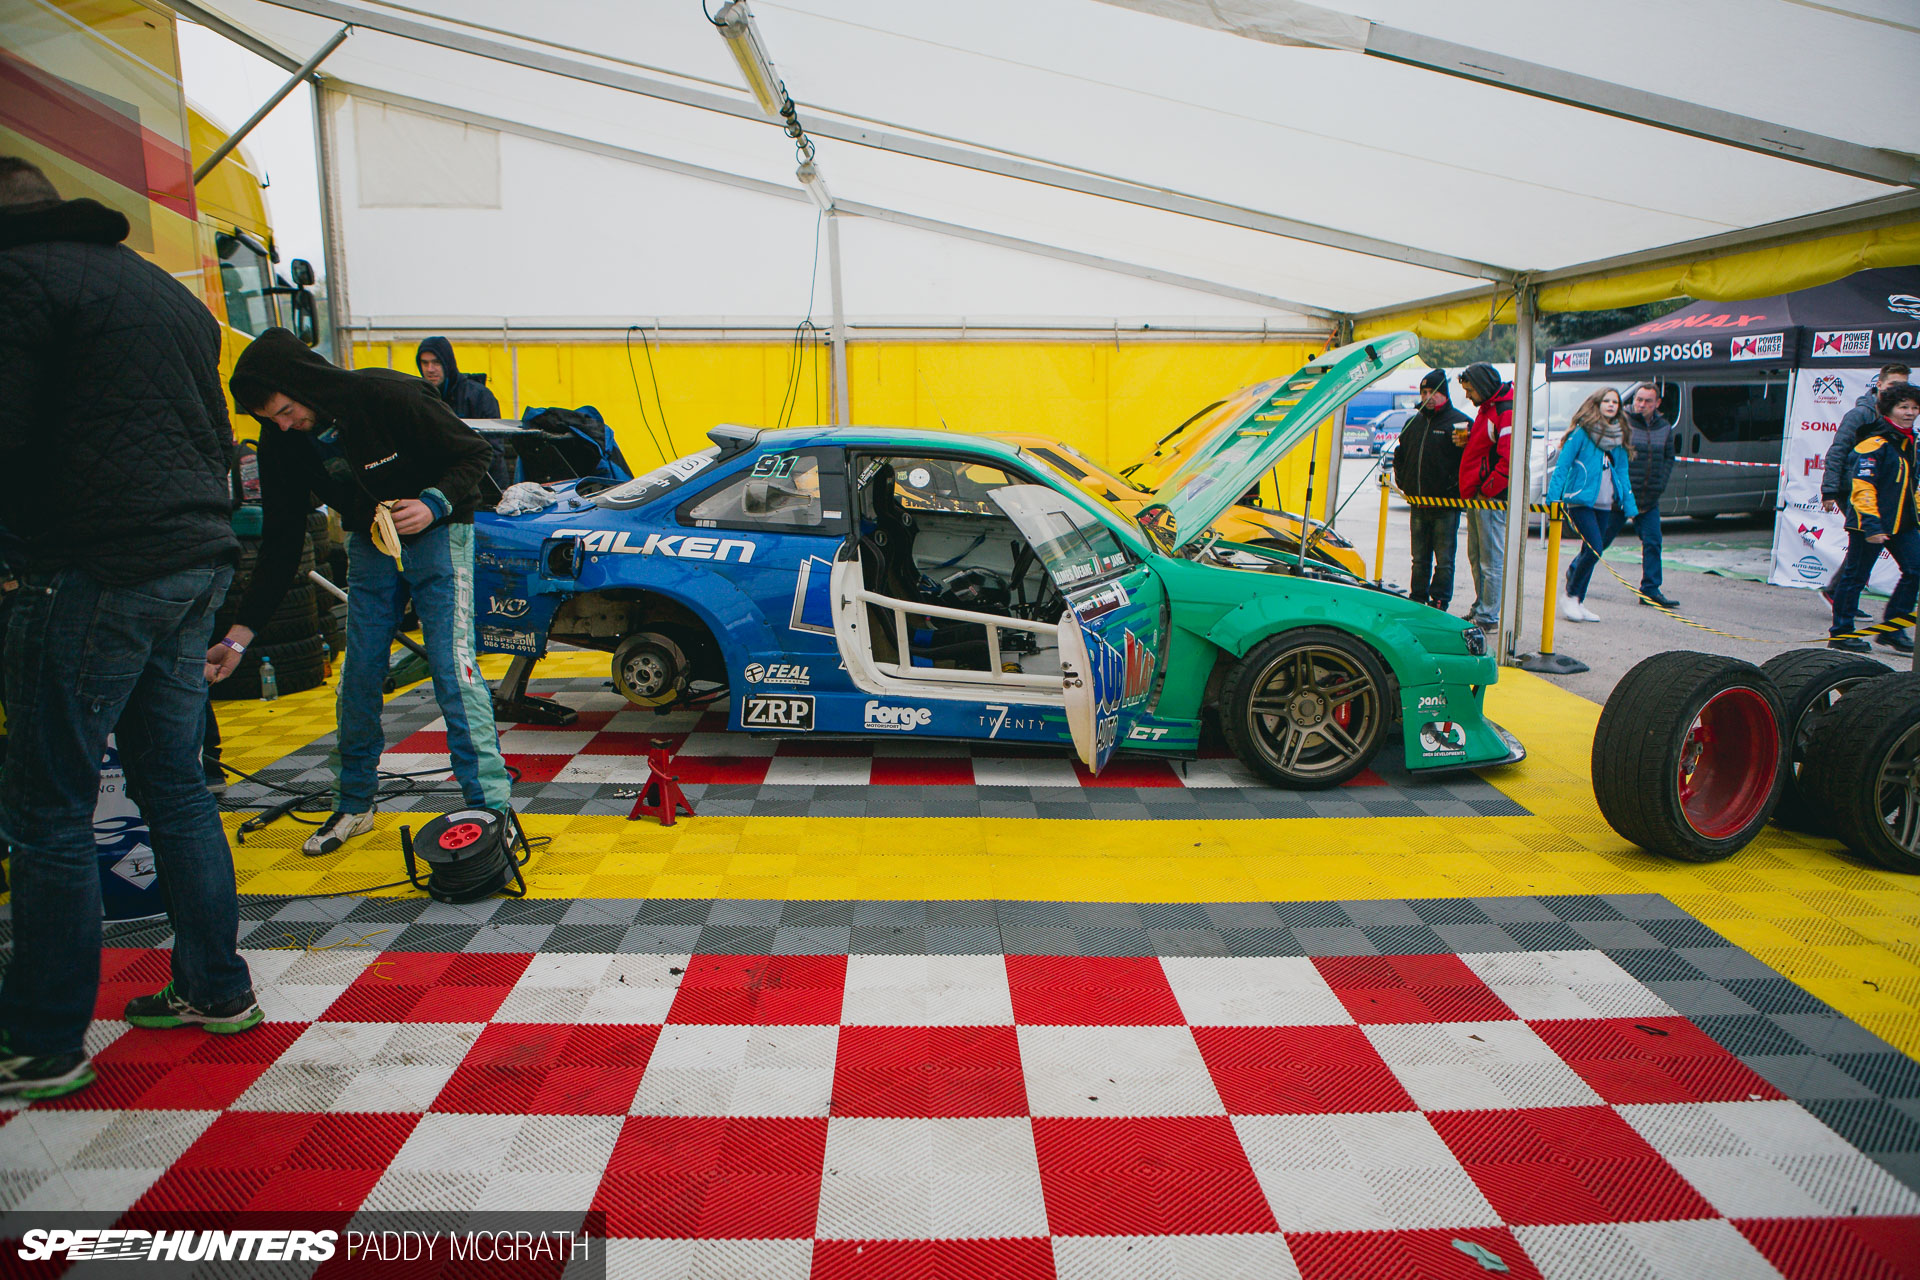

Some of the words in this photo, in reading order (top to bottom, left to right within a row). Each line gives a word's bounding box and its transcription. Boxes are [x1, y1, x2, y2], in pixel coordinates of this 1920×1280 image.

[1758, 336, 1782, 344] POWER
[1843, 341, 1869, 350] HORSE
[1844, 333, 1870, 341] POWER
[1604, 346, 1651, 366] DAWID
[1653, 339, 1713, 361] SPOSÓB
[1757, 343, 1781, 353] HORSE
[1801, 421, 1837, 432] SONA
[364, 452, 398, 470] FALKEN
[751, 454, 799, 478] 91
[488, 595, 530, 617] WCP
[456, 567, 476, 685] FALKEN
[484, 640, 499, 648] 086
[501, 642, 515, 650] 250
[516, 645, 537, 653] 4910
[766, 664, 810, 680] FEAL
[747, 699, 809, 724] ZRP
[1126, 720, 1168, 740] CT
